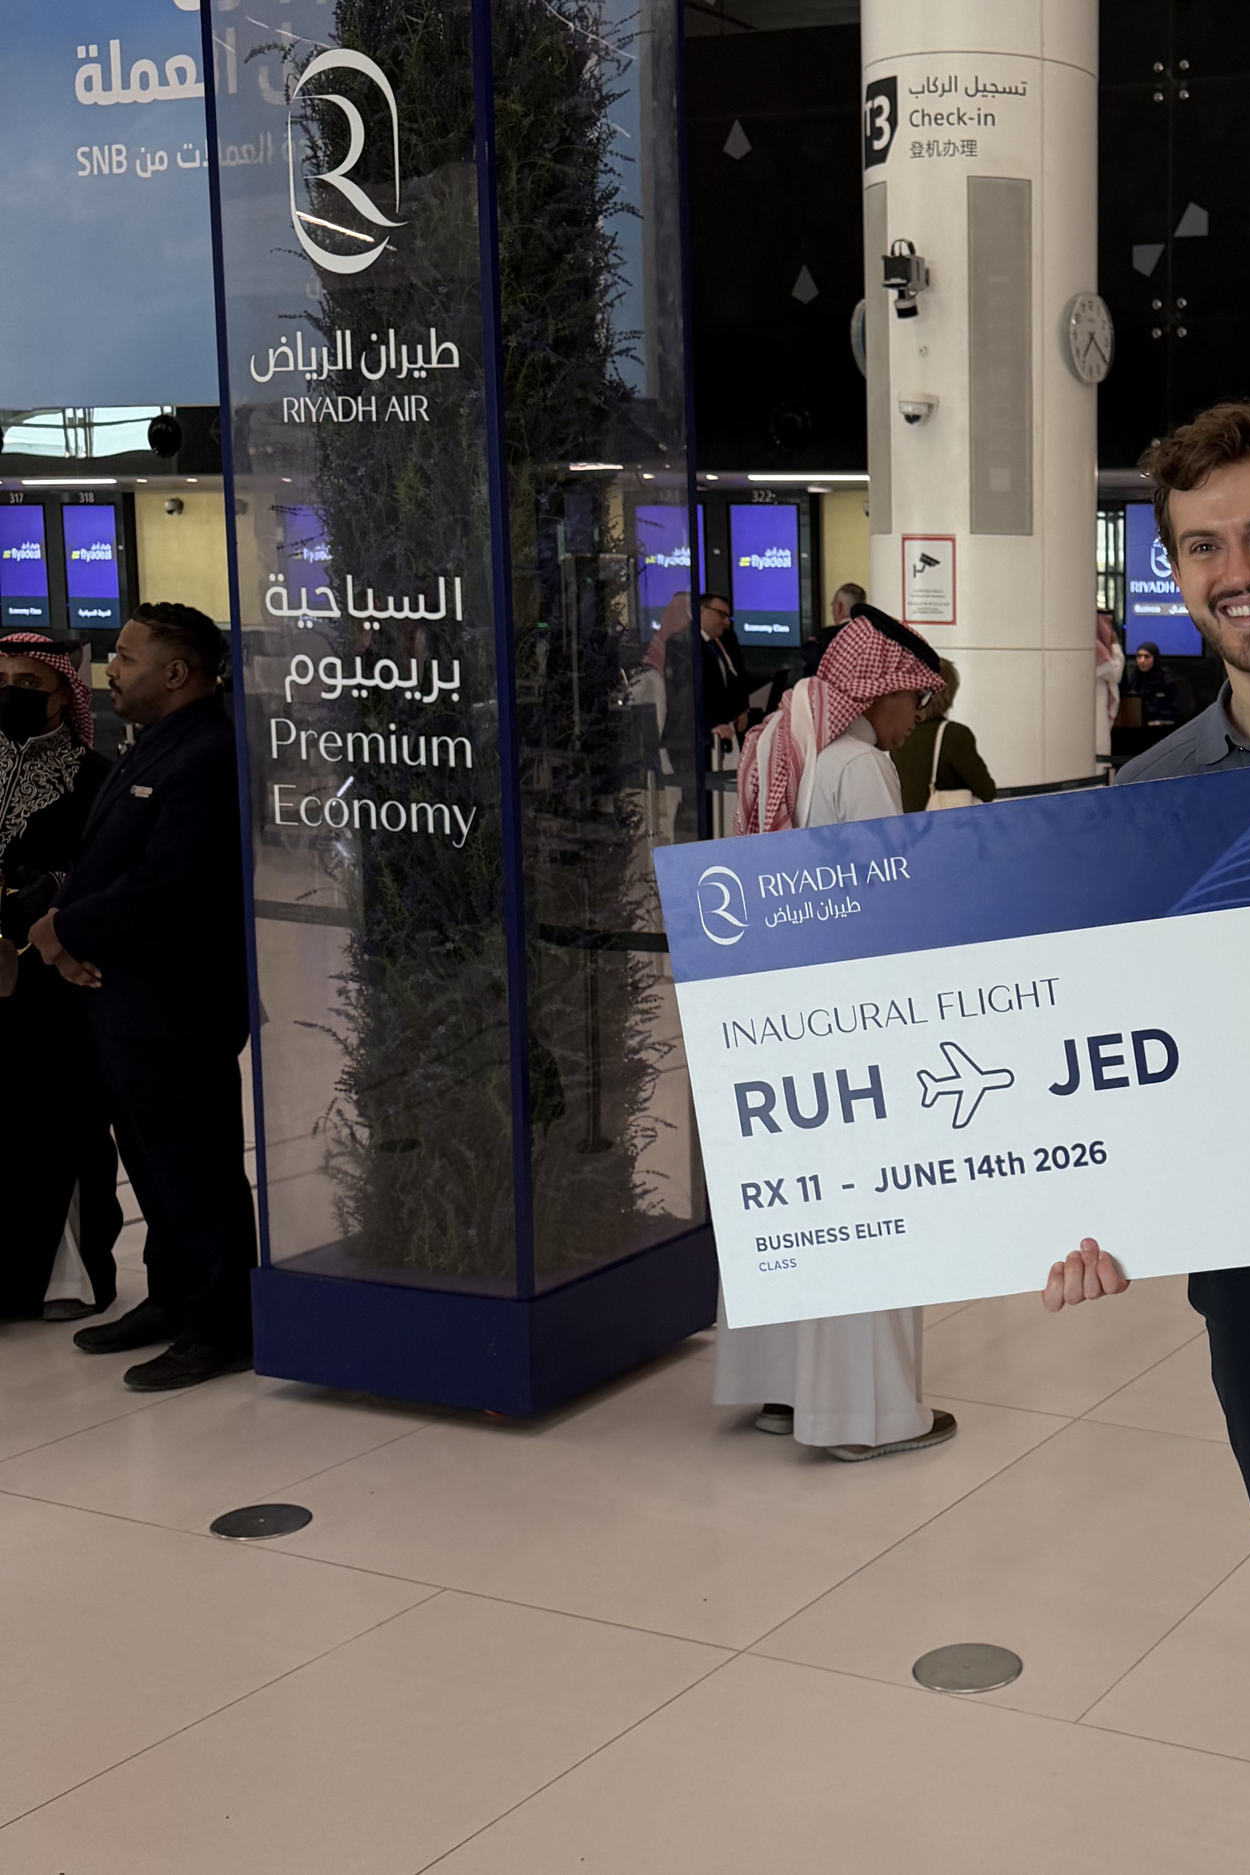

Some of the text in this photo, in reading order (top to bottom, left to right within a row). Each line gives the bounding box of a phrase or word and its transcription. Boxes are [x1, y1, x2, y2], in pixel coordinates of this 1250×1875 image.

[908, 75, 1028, 99] تسجيل الركاب
[908, 107, 996, 127] Check-in
[76, 144, 127, 176] SNB
[135, 147, 168, 178] من
[909, 139, 978, 159] 登机办理
[250, 327, 460, 383] طيران الرياض
[283, 394, 430, 423] RIYADH AIR
[9, 493, 24, 504] 317
[265, 573, 463, 630] السياحية
[1130, 580, 1175, 594] RIYADH
[284, 654, 461, 703] بريميوم
[270, 717, 473, 768] Premium
[273, 784, 477, 848] Economy
[758, 856, 911, 898] RIYADH AIR
[765, 896, 861, 928] طيران الرياض
[721, 977, 1060, 1049] INAUGURAL FLIGHT
[1048, 1028, 1180, 1096] JED
[734, 1064, 887, 1137] RUH
[740, 1178, 789, 1210] RX
[796, 1174, 822, 1203] 11
[874, 1159, 957, 1194] JUNE
[964, 1151, 1026, 1182] 14th
[1033, 1140, 1108, 1173] 2026
[755, 1218, 906, 1252] BUSINESS ELITE
[759, 1258, 798, 1273] CLASS
